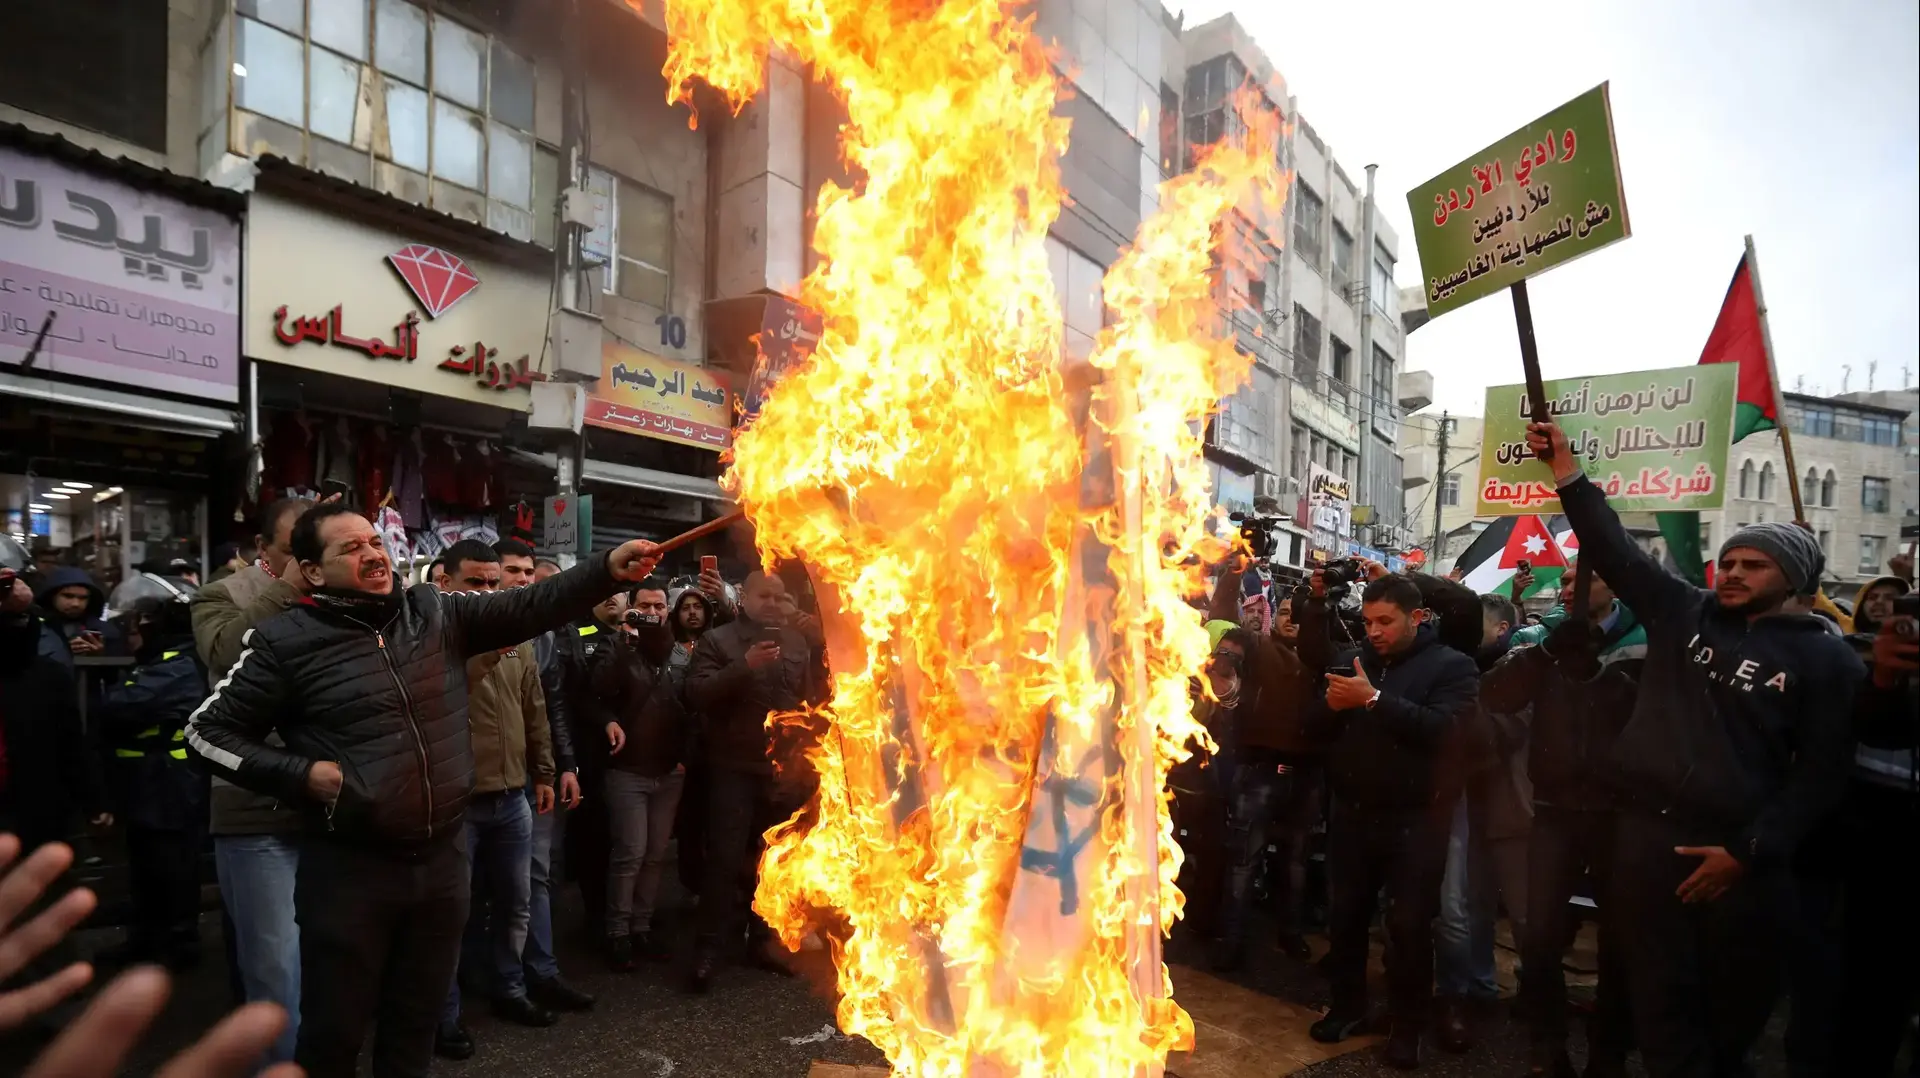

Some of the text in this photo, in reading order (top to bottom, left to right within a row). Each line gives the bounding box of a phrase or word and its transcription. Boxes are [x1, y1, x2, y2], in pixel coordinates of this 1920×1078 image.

[1433, 128, 1576, 226] وادي الأردن
[1473, 183, 1551, 244] للأردنيين
[1430, 199, 1611, 302] مش للصهاينة الغاصبين
[38, 281, 120, 316] تقليدية
[124, 300, 216, 336] مجوهرات
[654, 314, 687, 349] 10
[274, 302, 547, 391] طرزات ألماس
[611, 361, 685, 398] الرحيم
[691, 383, 726, 409] عبد
[1662, 378, 1694, 411] لن
[603, 405, 647, 427] زعتر
[1594, 385, 1655, 416] نرهن
[653, 415, 694, 437] بهارات
[700, 427, 726, 444] بن
[1604, 421, 1705, 460] للإحتلال
[1484, 480, 1561, 505] جريمة
[1626, 464, 1713, 500] شركاء
[1687, 633, 1788, 693] IDEA
